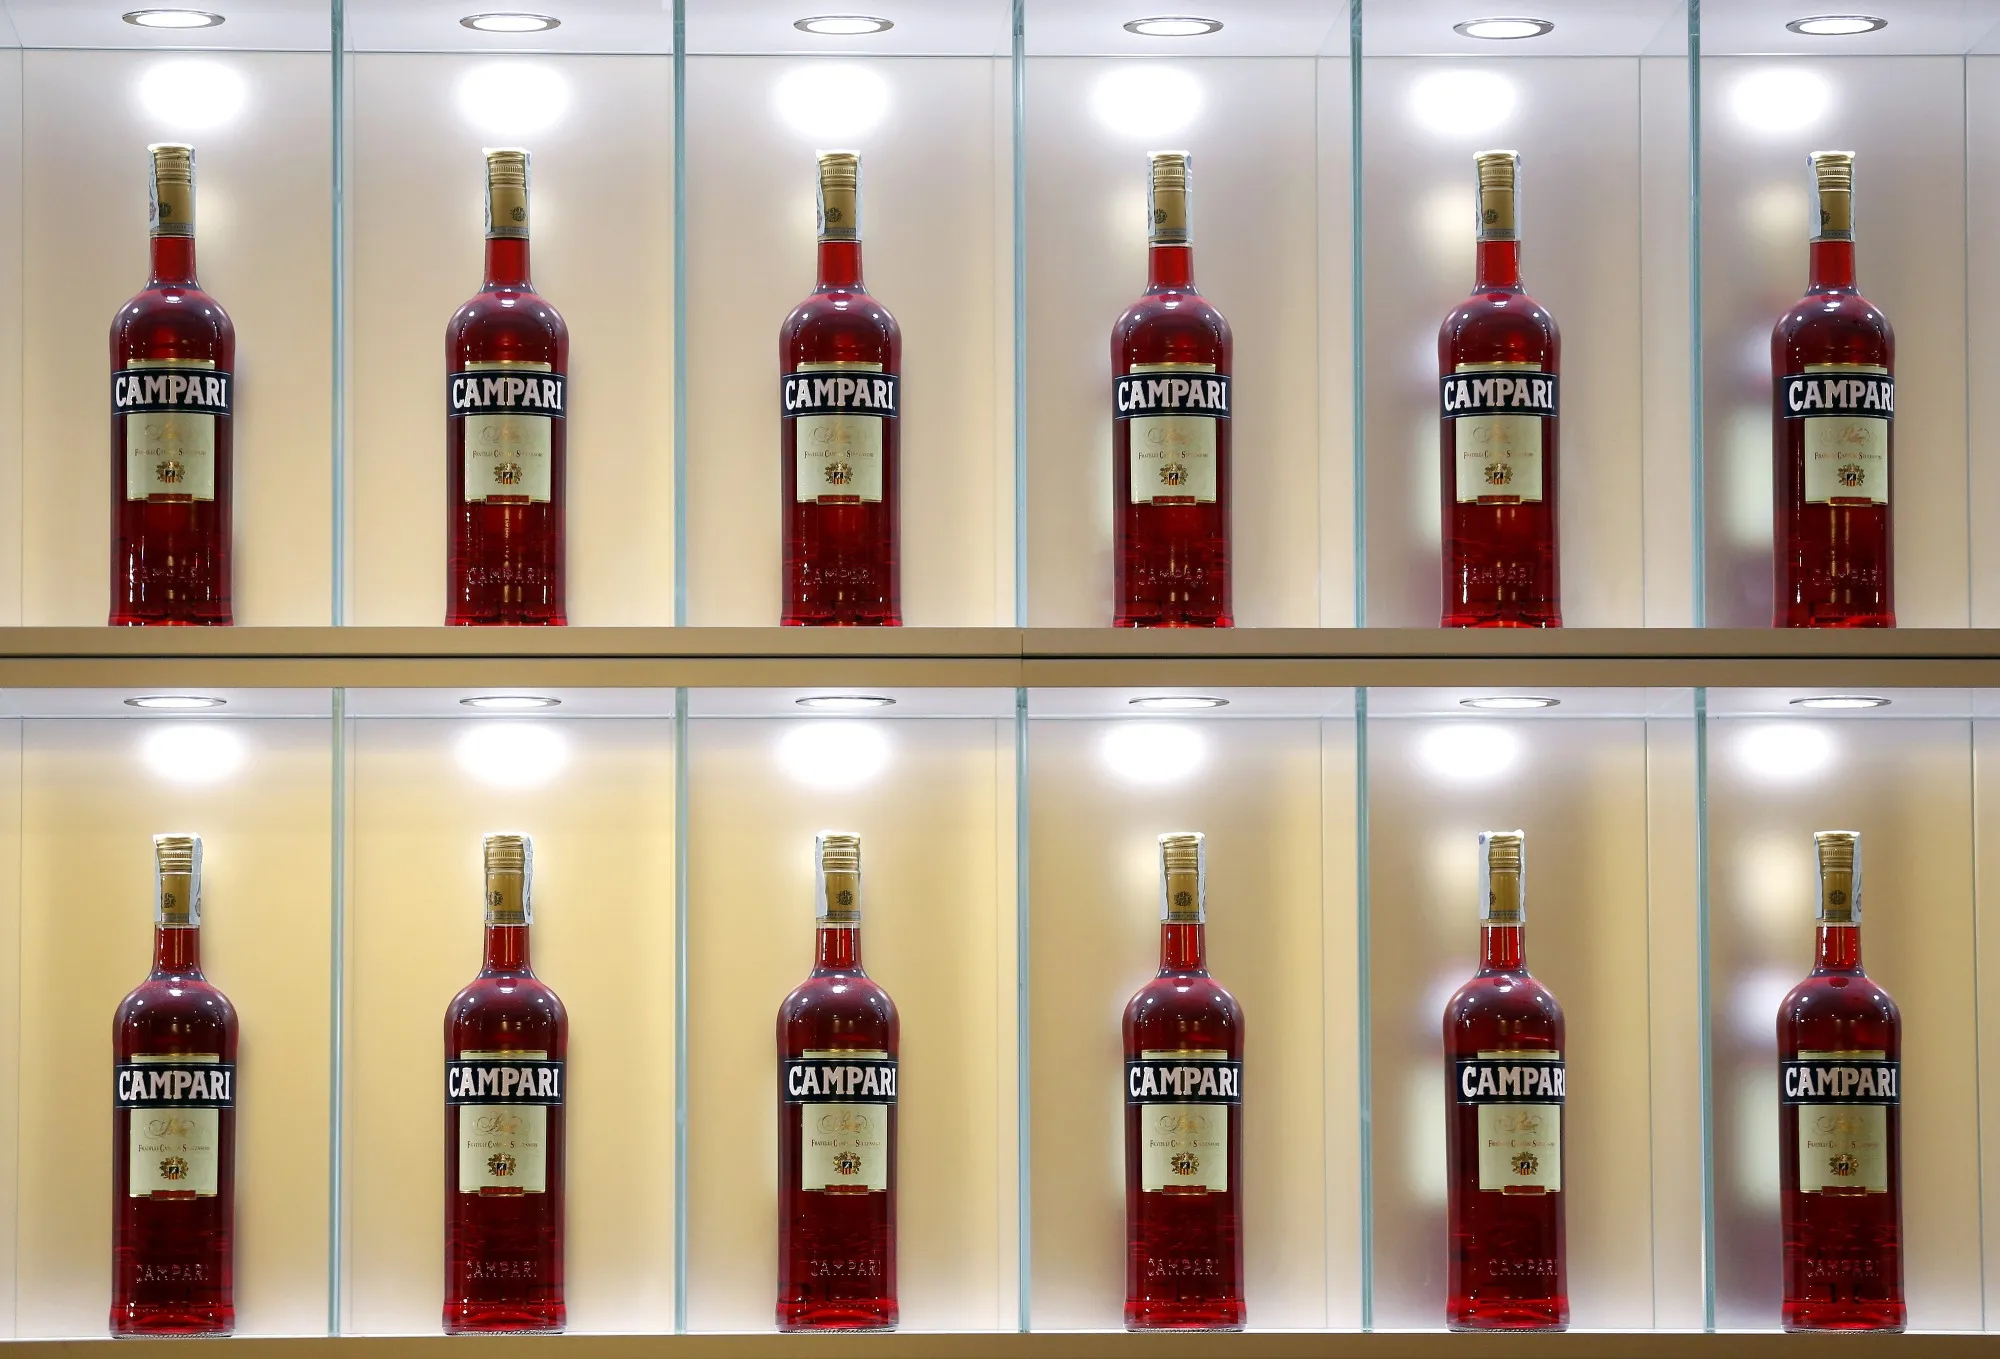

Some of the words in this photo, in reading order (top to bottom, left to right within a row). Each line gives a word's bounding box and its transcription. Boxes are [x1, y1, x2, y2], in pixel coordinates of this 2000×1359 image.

[116, 376, 227, 408] CAMPARI
[453, 378, 562, 409] CAMPARI
[786, 378, 895, 410] CAMPARI
[1118, 379, 1228, 411] CAMPARI
[1444, 379, 1553, 411] CAMPARI
[1789, 379, 1895, 411] CAMPARI
[119, 1071, 231, 1101] CAMPARI
[449, 1068, 559, 1098] CAMPARI
[789, 1066, 896, 1096] CAMPARI
[1130, 1067, 1239, 1097] CAMPARI
[1462, 1066, 1565, 1097] CAMPARI
[1786, 1067, 1896, 1097] CAMPARI
